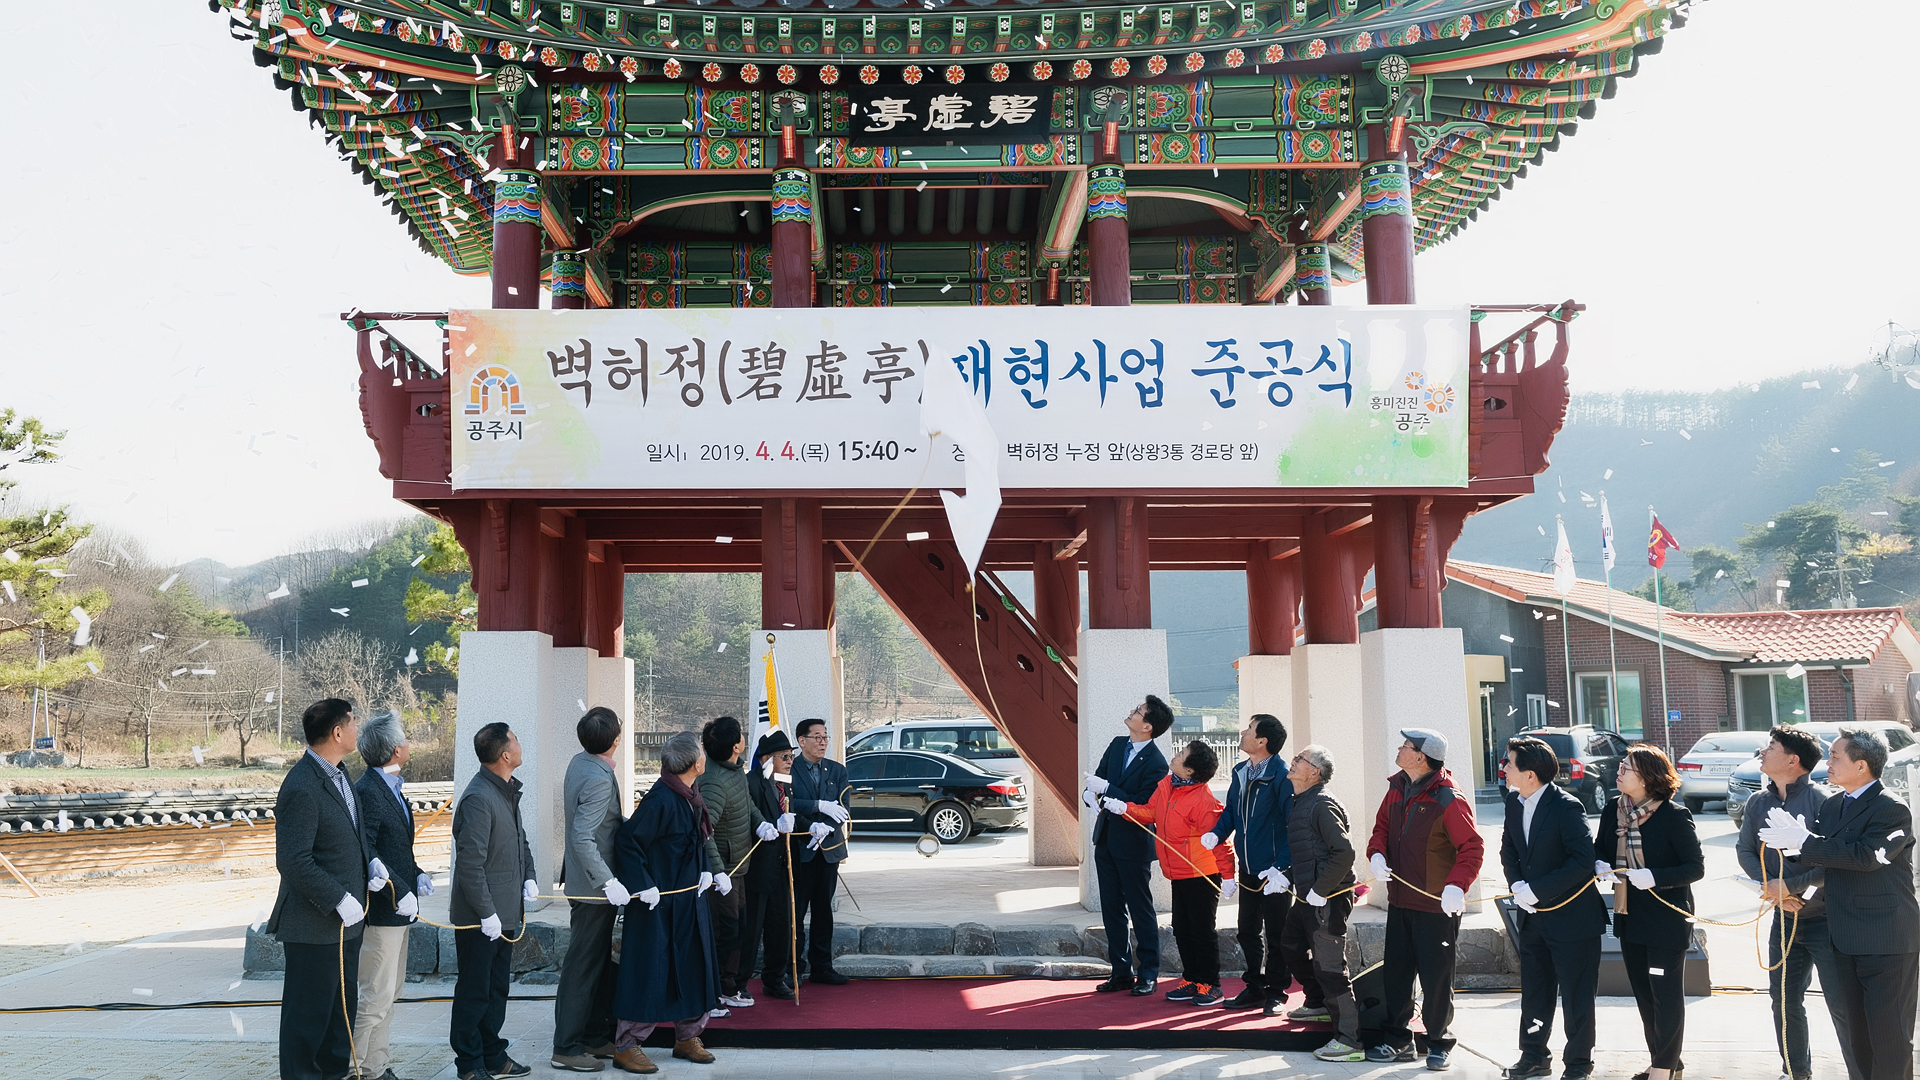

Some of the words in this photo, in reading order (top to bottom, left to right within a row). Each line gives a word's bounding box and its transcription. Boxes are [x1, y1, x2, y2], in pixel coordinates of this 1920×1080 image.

[952, 338, 1165, 410] 재현사업
[1191, 338, 1353, 409] 준공식
[1370, 396, 1418, 410] 흥미진진
[466, 421, 522, 440] 공주시
[1395, 413, 1431, 431] 공주
[700, 444, 749, 461] 2019.
[1007, 442, 1058, 462] 벽허정
[1065, 442, 1100, 462] 누정
[1190, 443, 1234, 461] 경로당
[1239, 443, 1259, 461] 앞)
